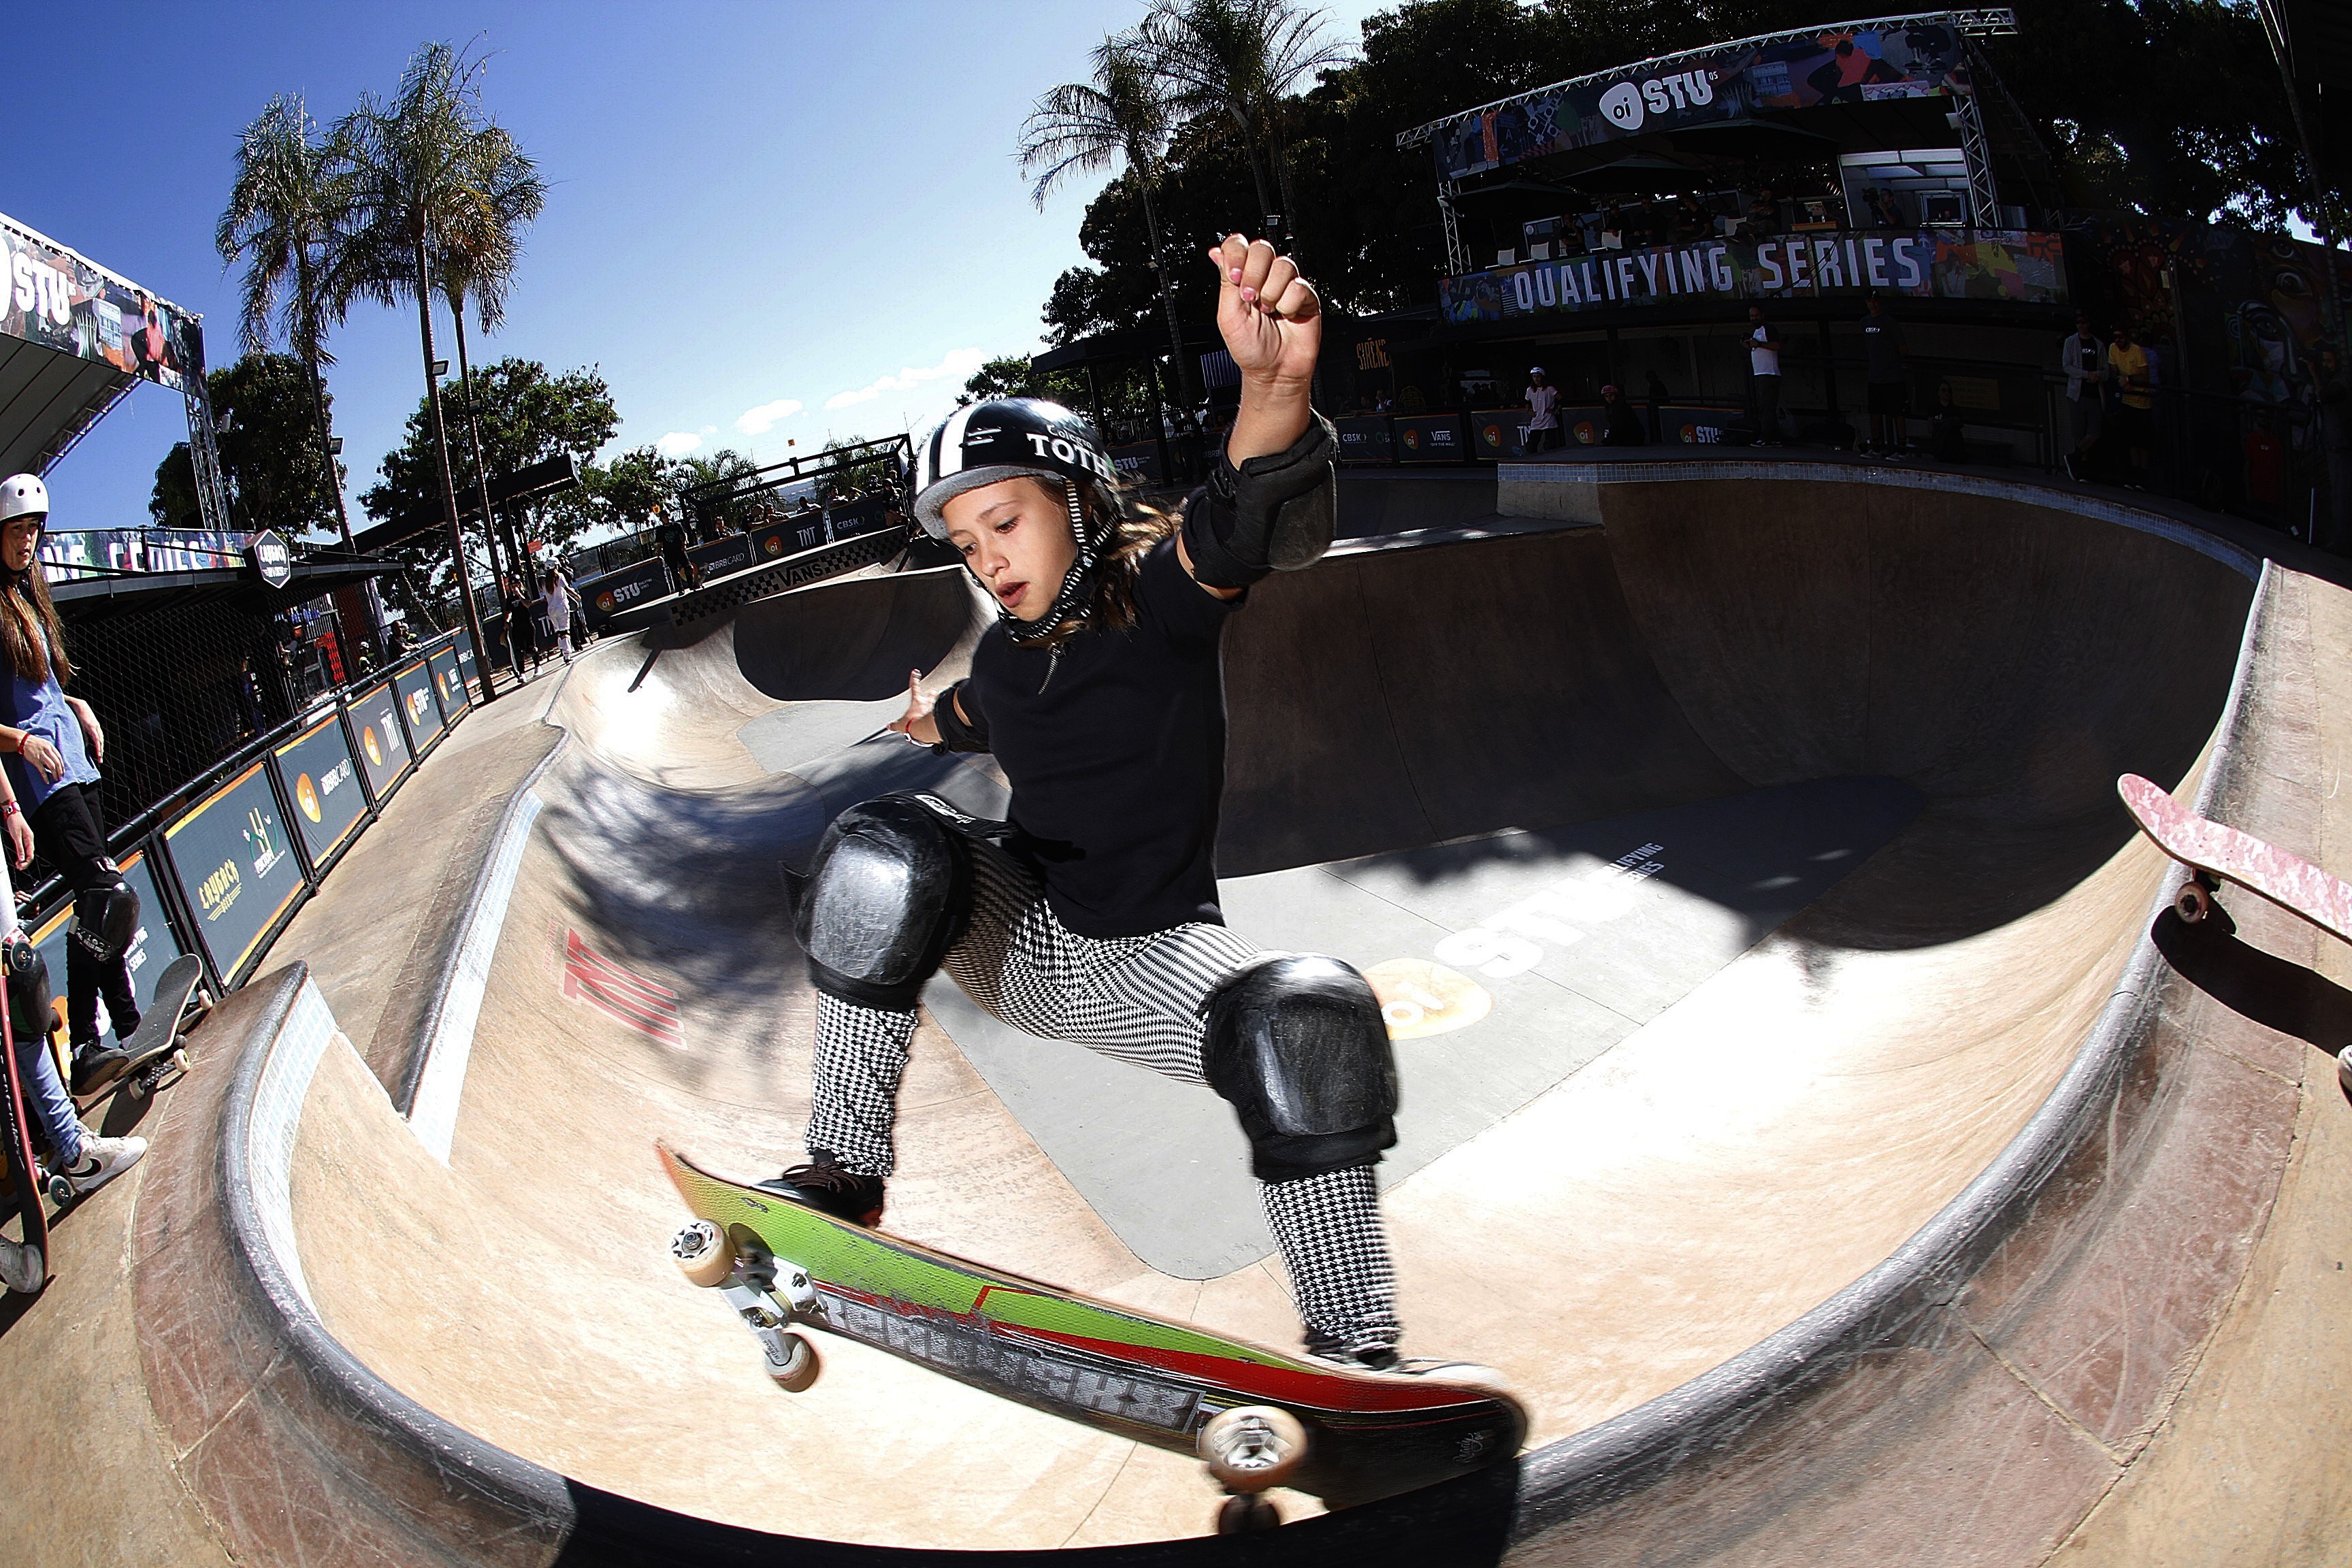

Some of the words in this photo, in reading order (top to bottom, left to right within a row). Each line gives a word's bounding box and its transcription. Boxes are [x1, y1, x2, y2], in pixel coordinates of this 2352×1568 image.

[1613, 97, 1631, 120] oi
[1642, 69, 1713, 114] STU
[1514, 246, 1733, 310] QUALIFYING
[1758, 236, 1921, 289] SERIES
[14, 252, 70, 325] STU
[1343, 433, 1361, 442] CBSK
[1407, 436, 1415, 445] oi
[1431, 429, 1451, 441] VANS
[1488, 431, 1496, 442] oi
[1579, 429, 1588, 440] oi
[1026, 433, 1112, 482] TOTH
[1115, 456, 1139, 471] STU
[796, 526, 816, 547] TNT
[836, 518, 859, 529] CBSK
[776, 558, 823, 587] VANS
[602, 598, 610, 608] oi
[613, 582, 641, 603] STU
[413, 689, 427, 715] STU
[380, 713, 400, 751] TNT
[198, 859, 240, 909] LAYBACK
